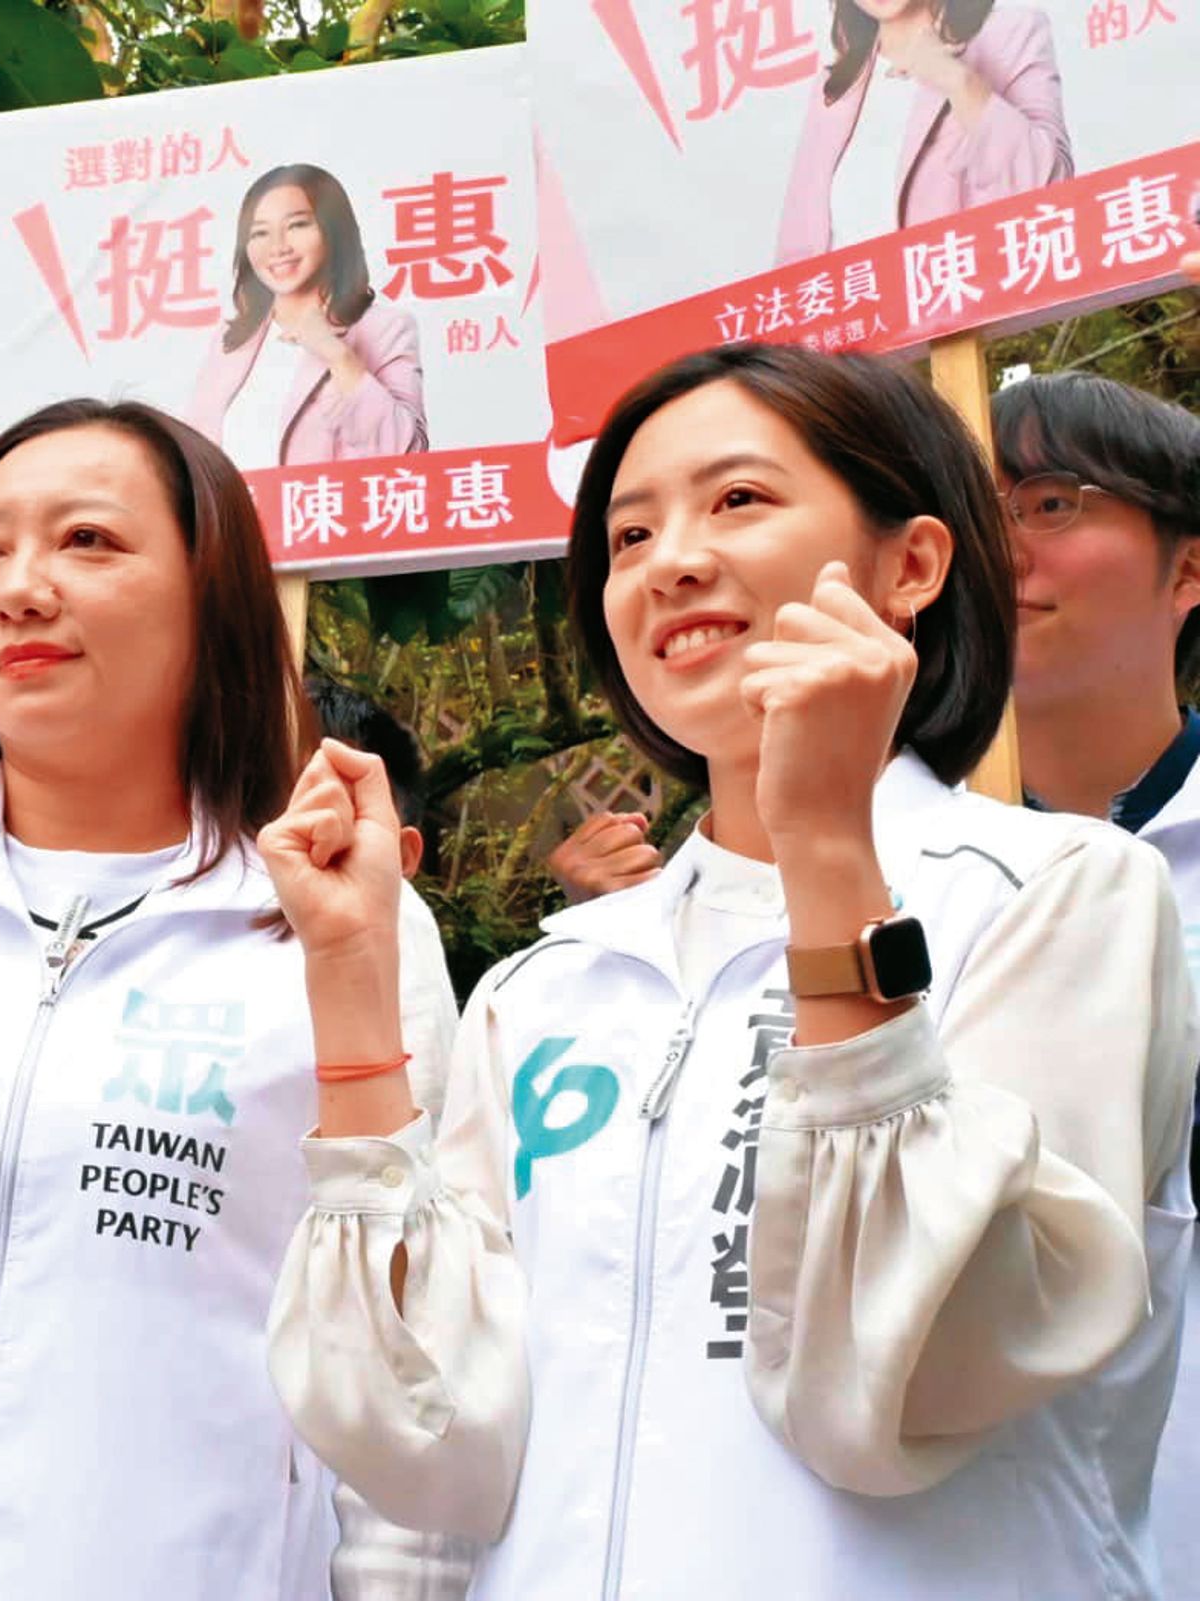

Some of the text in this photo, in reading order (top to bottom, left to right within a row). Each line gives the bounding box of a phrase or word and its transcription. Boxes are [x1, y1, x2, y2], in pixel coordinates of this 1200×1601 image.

[63, 125, 250, 192] 選對的人
[96, 205, 222, 341] 挺
[381, 171, 514, 302] 惠
[903, 173, 1186, 326] 陳琬惠
[446, 315, 521, 355] 的人
[714, 259, 881, 344] 立法委員
[281, 459, 514, 547] 陳琬惠
[91, 1122, 226, 1172] TAIWAN
[80, 1164, 225, 1216] PEOPLE'S
[95, 1208, 201, 1252] PARTY
